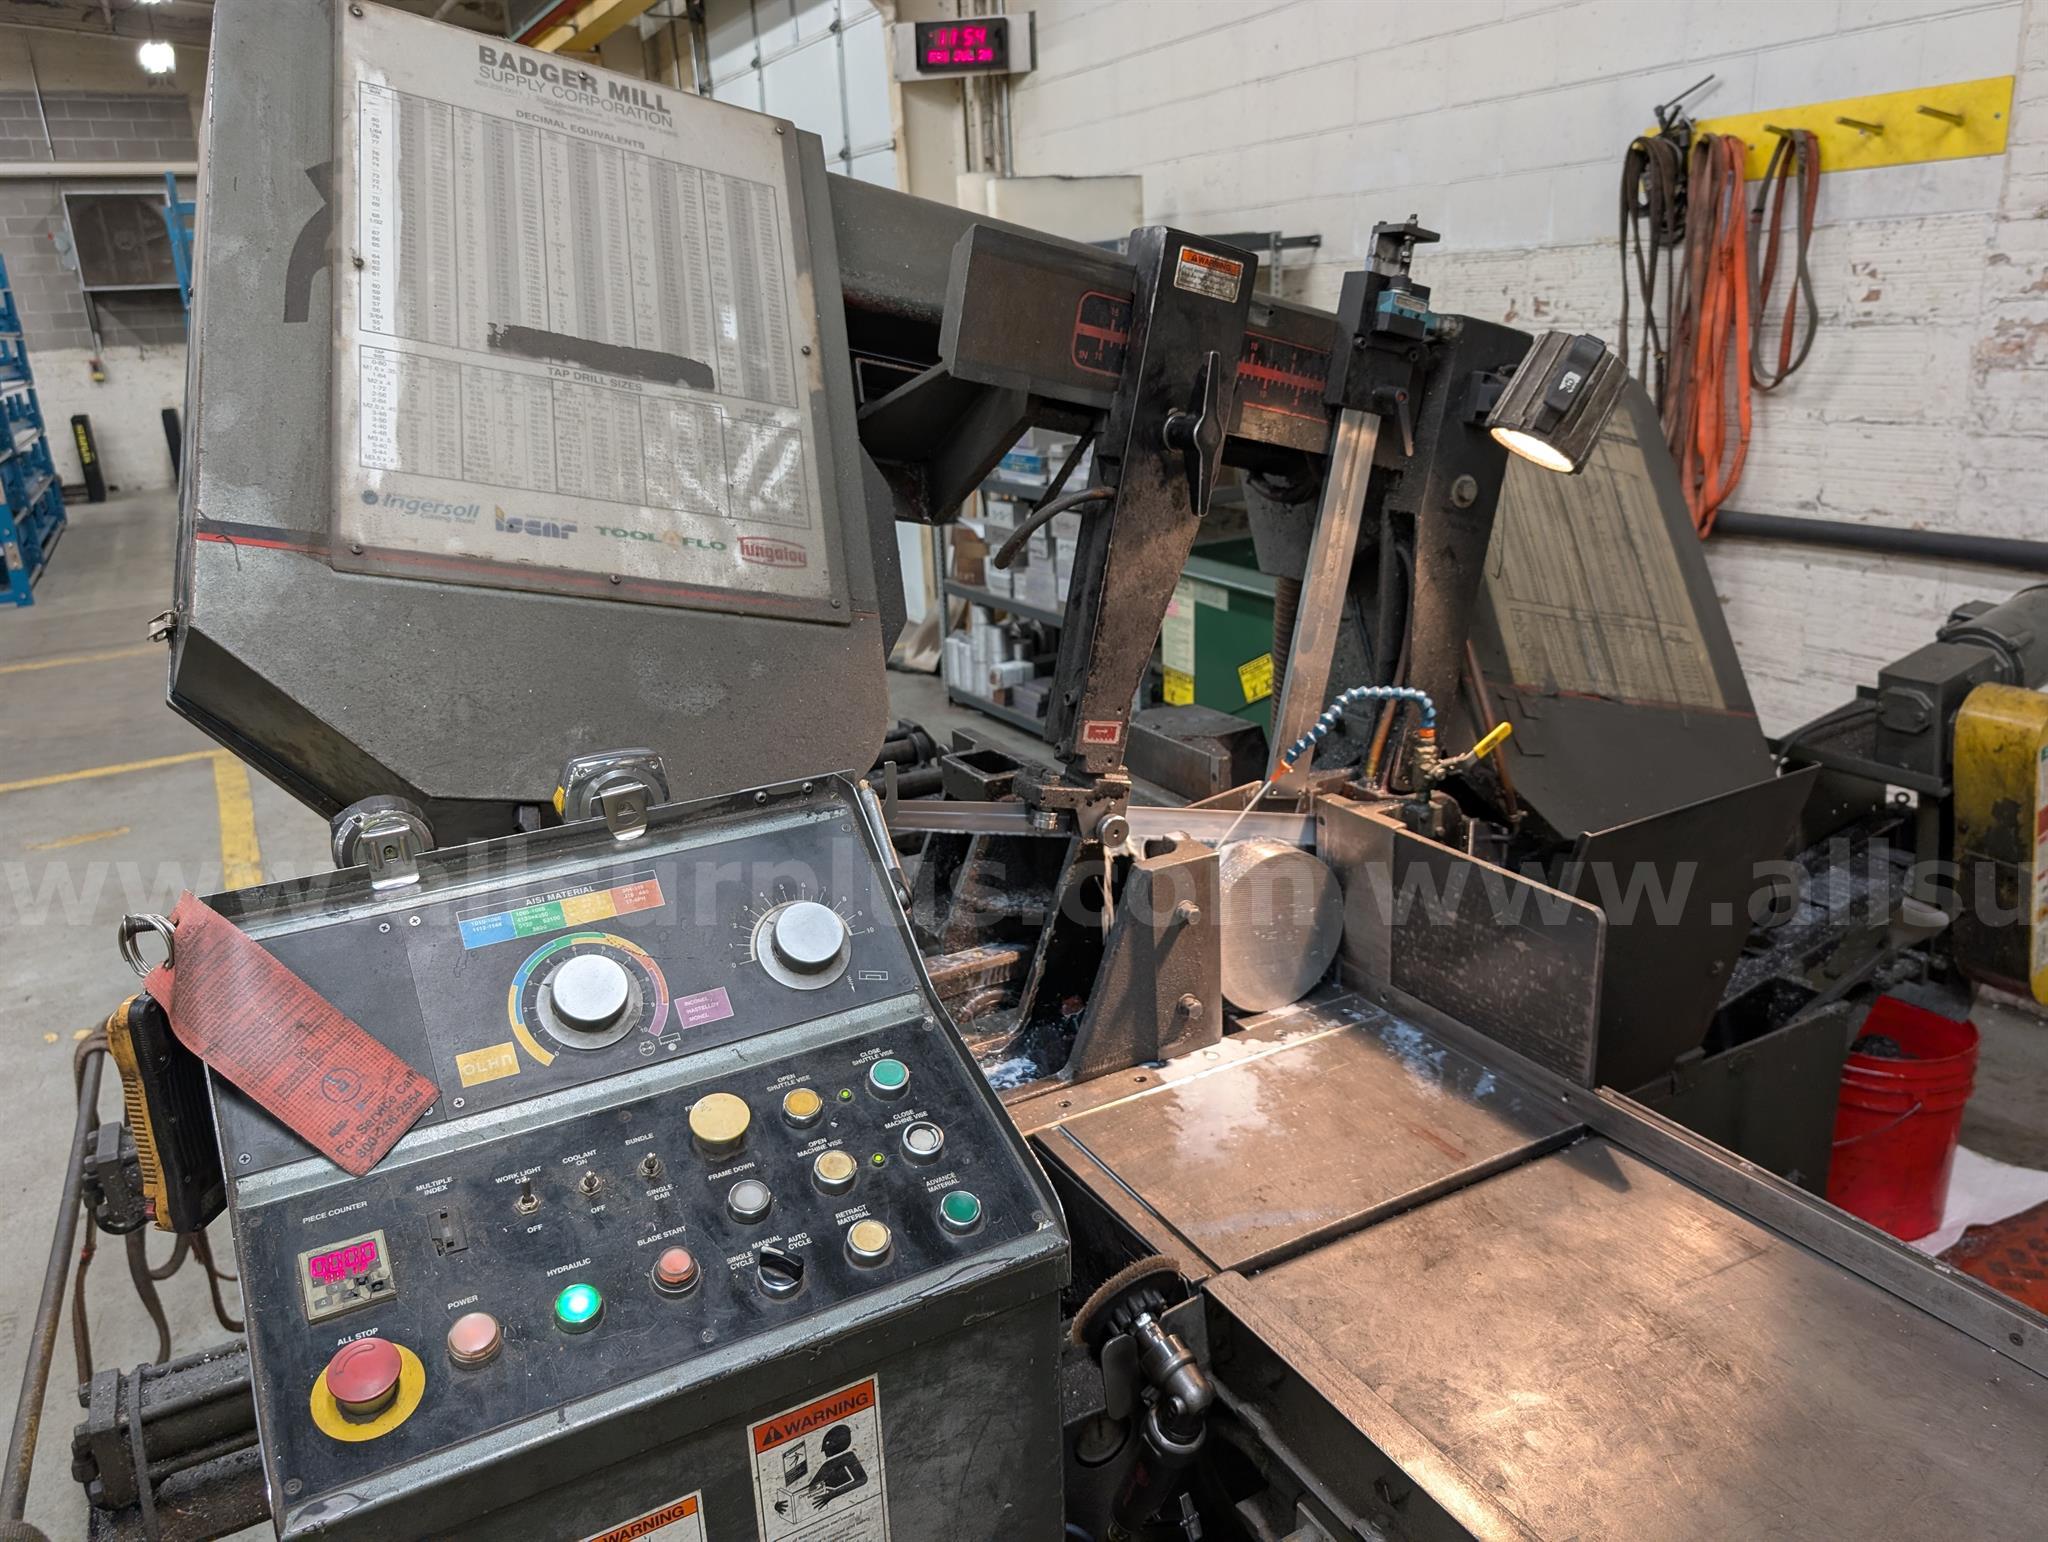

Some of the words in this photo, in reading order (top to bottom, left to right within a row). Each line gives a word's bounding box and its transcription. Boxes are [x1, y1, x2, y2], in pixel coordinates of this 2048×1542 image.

[479, 45, 598, 95] BADGER
[608, 80, 671, 115] MILL
[479, 66, 546, 93] SUPPLY
[552, 85, 673, 128] CORPORATION
[516, 110, 568, 130] DECIMAL
[570, 124, 645, 150] EQUIVALENTS
[547, 367, 570, 378] TAP
[573, 371, 607, 386] DRILL
[610, 378, 642, 391] SIZES
[383, 493, 480, 519] Ingersoll
[526, 894, 545, 906] AISI
[547, 885, 595, 901] MATERIAL
[852, 1053, 880, 1066] SHUTTLE
[878, 1049, 895, 1059] VISE
[860, 1047, 881, 1058] CLOSE
[766, 1079, 795, 1093] SHUTTLE
[794, 1074, 811, 1084] VISE
[777, 1073, 796, 1083] OPEN
[884, 1115, 914, 1129] MACHINE
[913, 1110, 929, 1121] VISE
[892, 1108, 914, 1120] CLOSE
[335, 1130, 358, 1157] For
[355, 1093, 398, 1135] Service
[624, 1132, 655, 1146] BUNDLE
[808, 1137, 827, 1148] OPEN
[797, 1144, 828, 1158] MACHINE
[826, 1138, 844, 1149] VISE
[562, 1149, 598, 1164] COOLANT
[576, 1158, 588, 1167] ON
[495, 1172, 519, 1185] WORK
[519, 1165, 543, 1179] LIGHT
[708, 1169, 733, 1181] FRAME
[733, 1161, 755, 1174] DOWN
[416, 1176, 453, 1192] MULTIPLE
[926, 1172, 955, 1187] ADVANCE
[928, 1178, 960, 1193] MATERIAL
[424, 1184, 448, 1196] INDEX
[646, 1183, 673, 1196] SINGLE
[302, 1211, 327, 1224] PIECE
[328, 1200, 368, 1216] COUNTER
[590, 1204, 606, 1214] OFF
[835, 1204, 867, 1219] RETRACT
[837, 1210, 872, 1226] MATERIAL
[527, 1223, 543, 1234] OFF
[637, 1232, 663, 1247] BLADE
[663, 1225, 687, 1239] START
[752, 1235, 782, 1249] MANUAL
[788, 1232, 808, 1244] AUTO
[788, 1237, 813, 1250] CYCLE
[726, 1250, 753, 1265] SINGLE
[730, 1257, 755, 1270] CYCLE
[547, 1257, 592, 1277] HYDRAULIC
[448, 1294, 479, 1310] POWER
[337, 1335, 354, 1346] ALL
[355, 1327, 379, 1340] STOP
[783, 1392, 869, 1439] WARNING
[602, 1504, 686, 1542] WARNING
